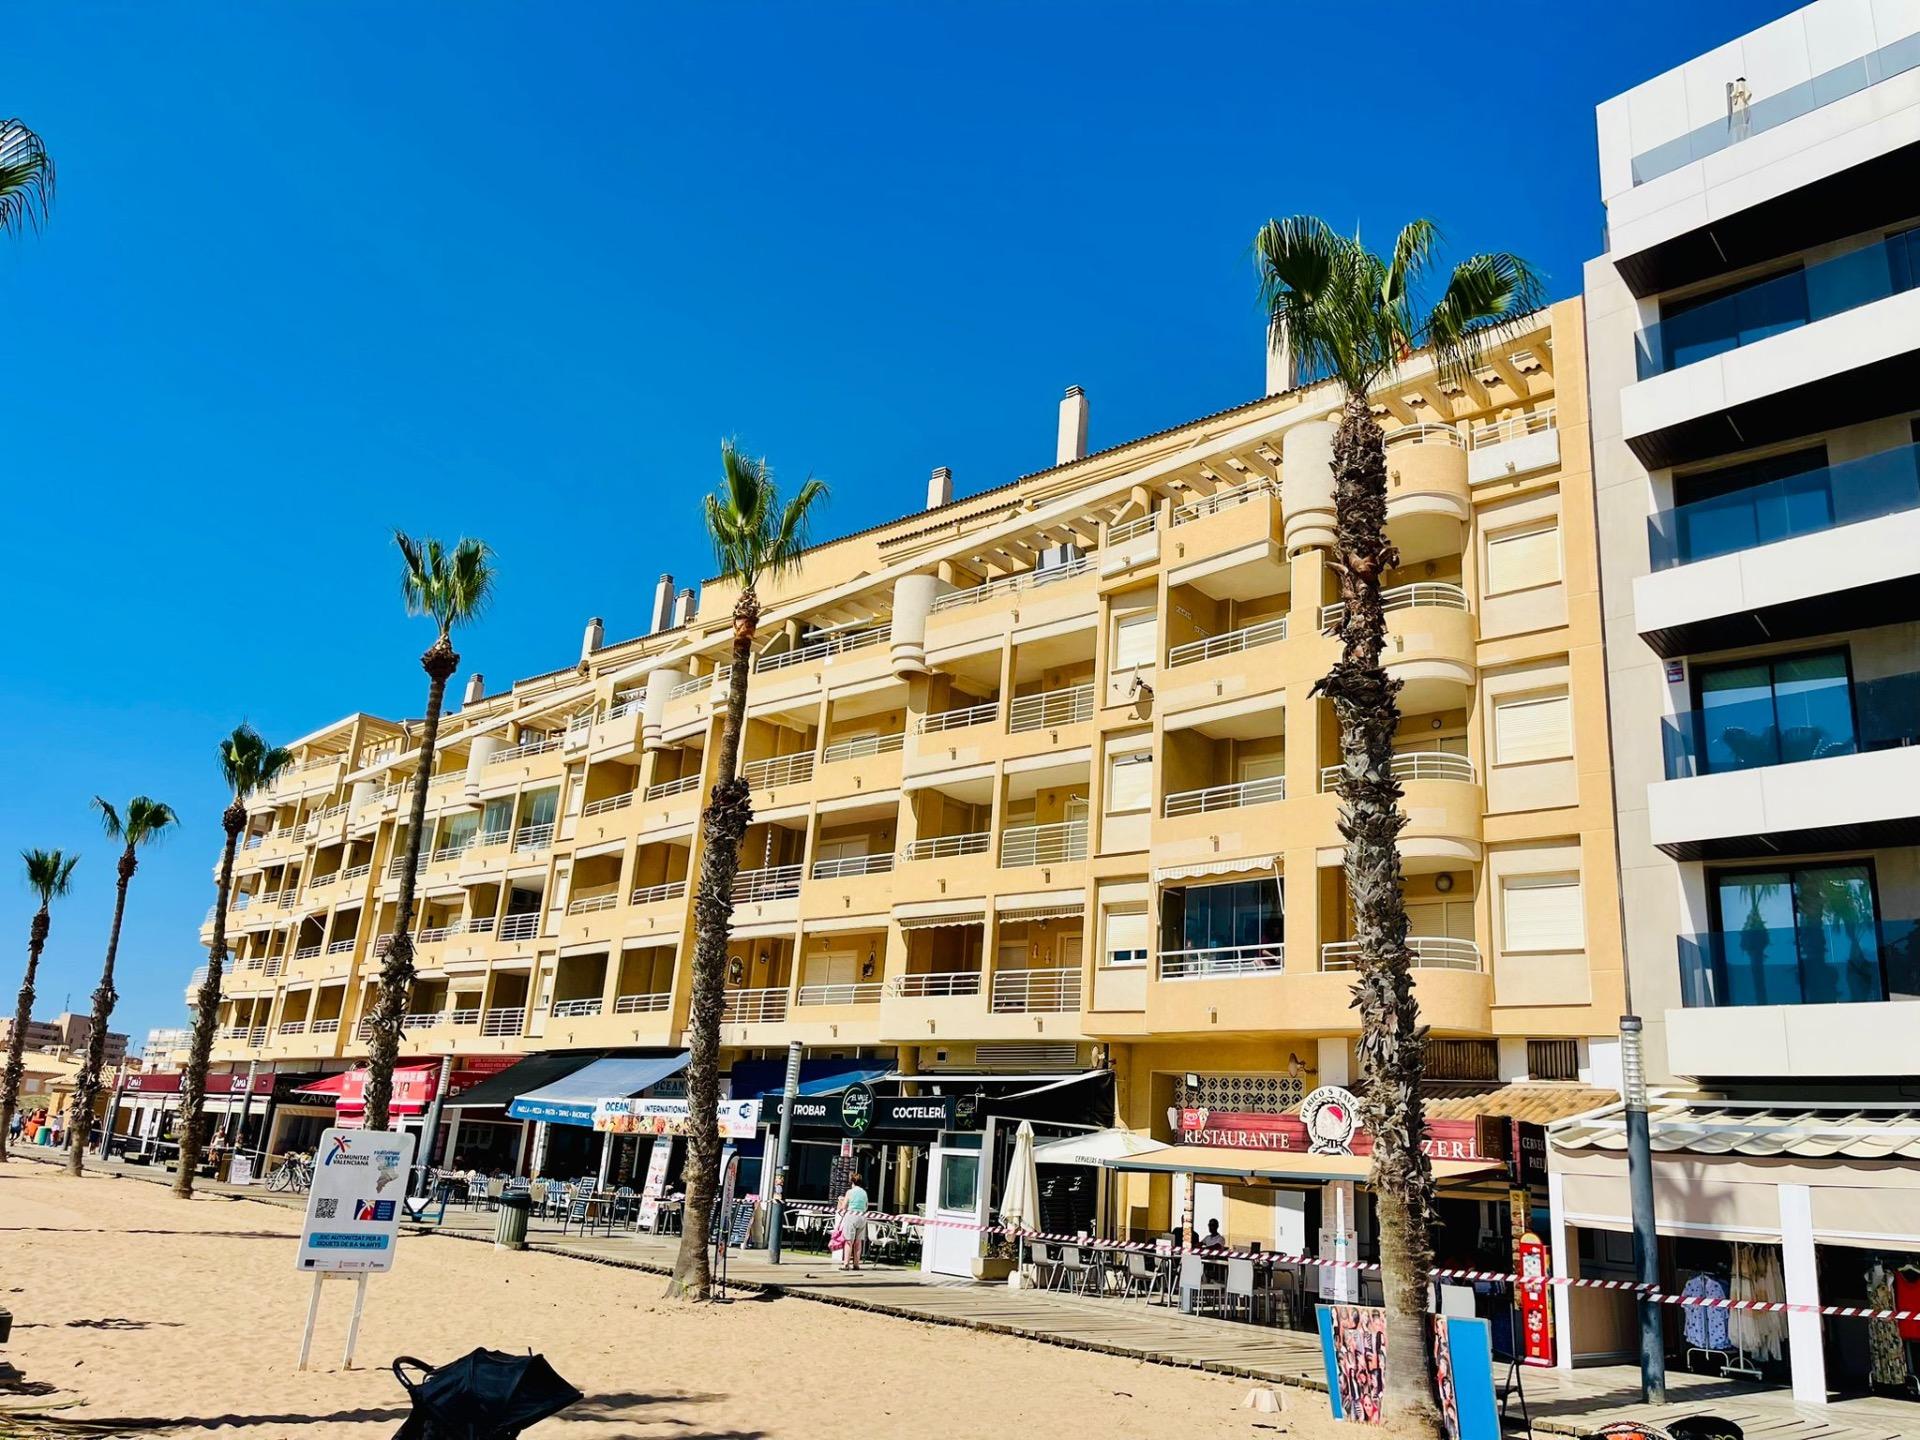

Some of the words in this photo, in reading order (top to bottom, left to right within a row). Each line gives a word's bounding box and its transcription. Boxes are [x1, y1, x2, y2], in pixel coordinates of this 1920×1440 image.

[653, 1081, 684, 1091] OCEAN
[605, 1101, 629, 1112] OCEAN
[644, 1104, 688, 1114] INTERNATIONAL
[777, 1104, 826, 1116] GTROBAR
[892, 1104, 947, 1119] COCTELERÍ
[1184, 1129, 1290, 1149] RESTAURANTE
